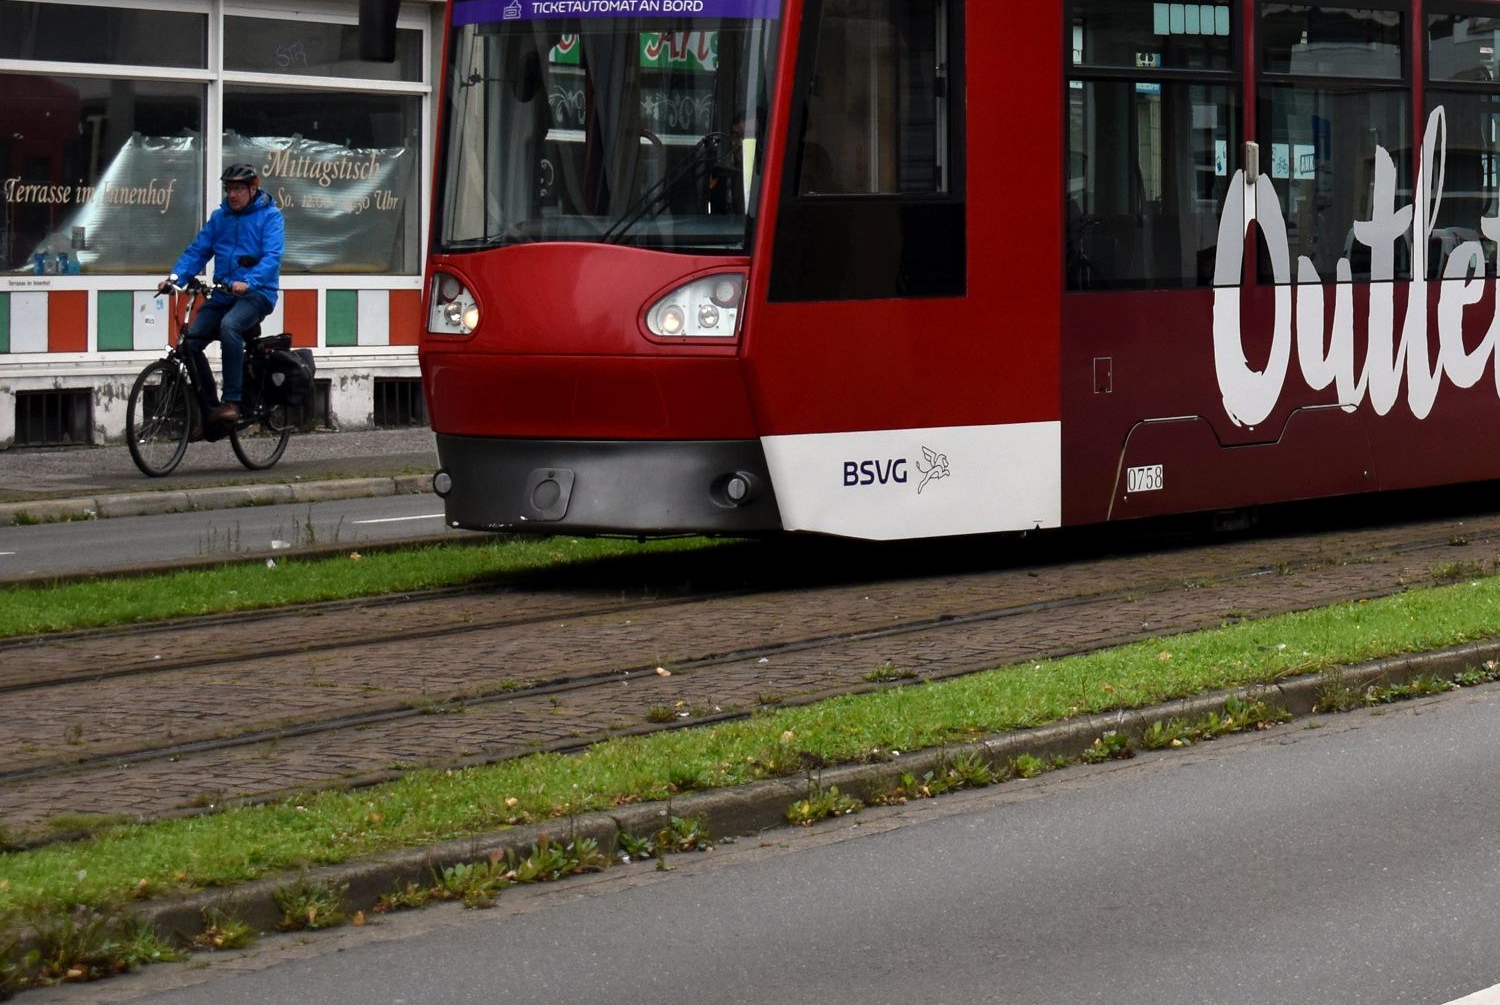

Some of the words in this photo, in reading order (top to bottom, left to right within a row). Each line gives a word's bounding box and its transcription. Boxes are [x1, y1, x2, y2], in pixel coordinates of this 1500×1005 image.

[532, 0, 637, 14] TICKETAUTOMAT
[639, 0, 659, 12] AN
[663, 0, 703, 12] BORD
[262, 149, 380, 187] Mittagstisch
[4, 176, 71, 204] Terrasse
[76, 178, 98, 204] im
[374, 190, 399, 210] Uhr
[843, 458, 907, 486] BSVG
[1128, 466, 1163, 491] 0758
